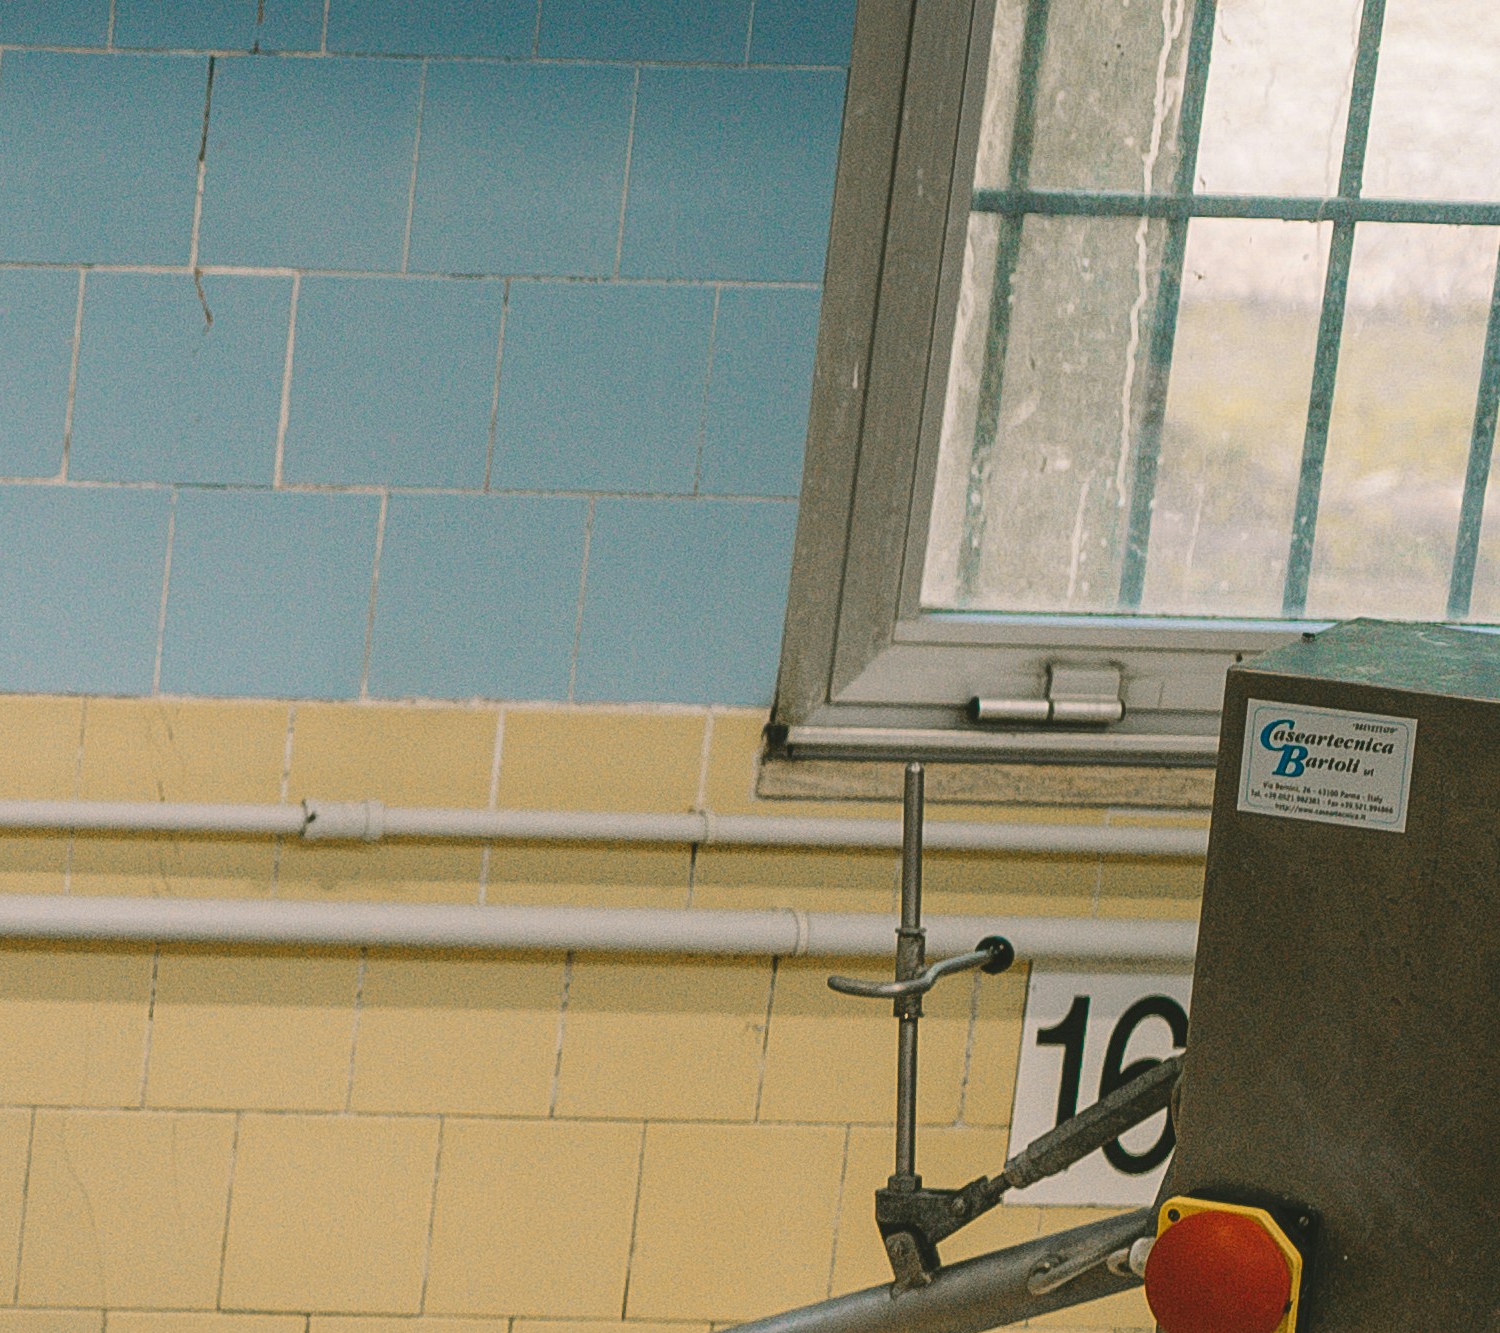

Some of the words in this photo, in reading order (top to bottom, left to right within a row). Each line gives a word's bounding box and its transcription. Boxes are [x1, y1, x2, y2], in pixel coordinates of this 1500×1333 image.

[1260, 719, 1394, 755] Caseartecnica
[1272, 744, 1360, 778] Bartoli
[1036, 993, 1189, 1176] 16
